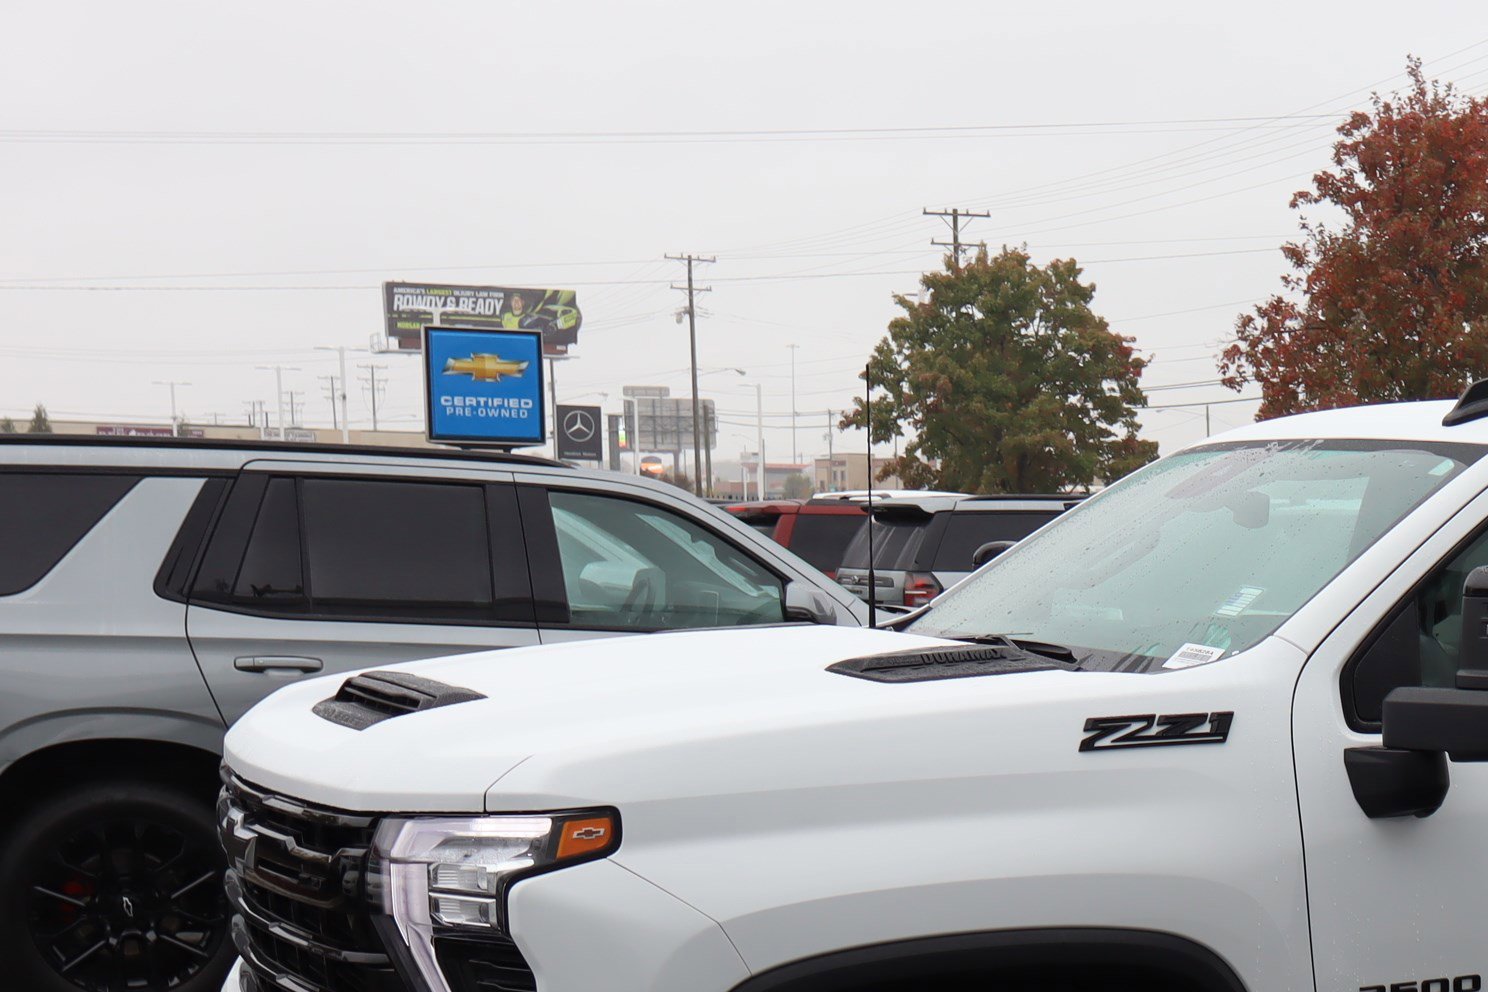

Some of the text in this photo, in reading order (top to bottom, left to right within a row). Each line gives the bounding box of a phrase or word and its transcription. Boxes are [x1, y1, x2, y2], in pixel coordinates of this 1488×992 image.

[394, 294, 504, 315] ROWDY & READY
[440, 395, 533, 409] CERTIFIED
[446, 407, 528, 419] PRE-OWNED
[920, 648, 1009, 665] DURAMAX
